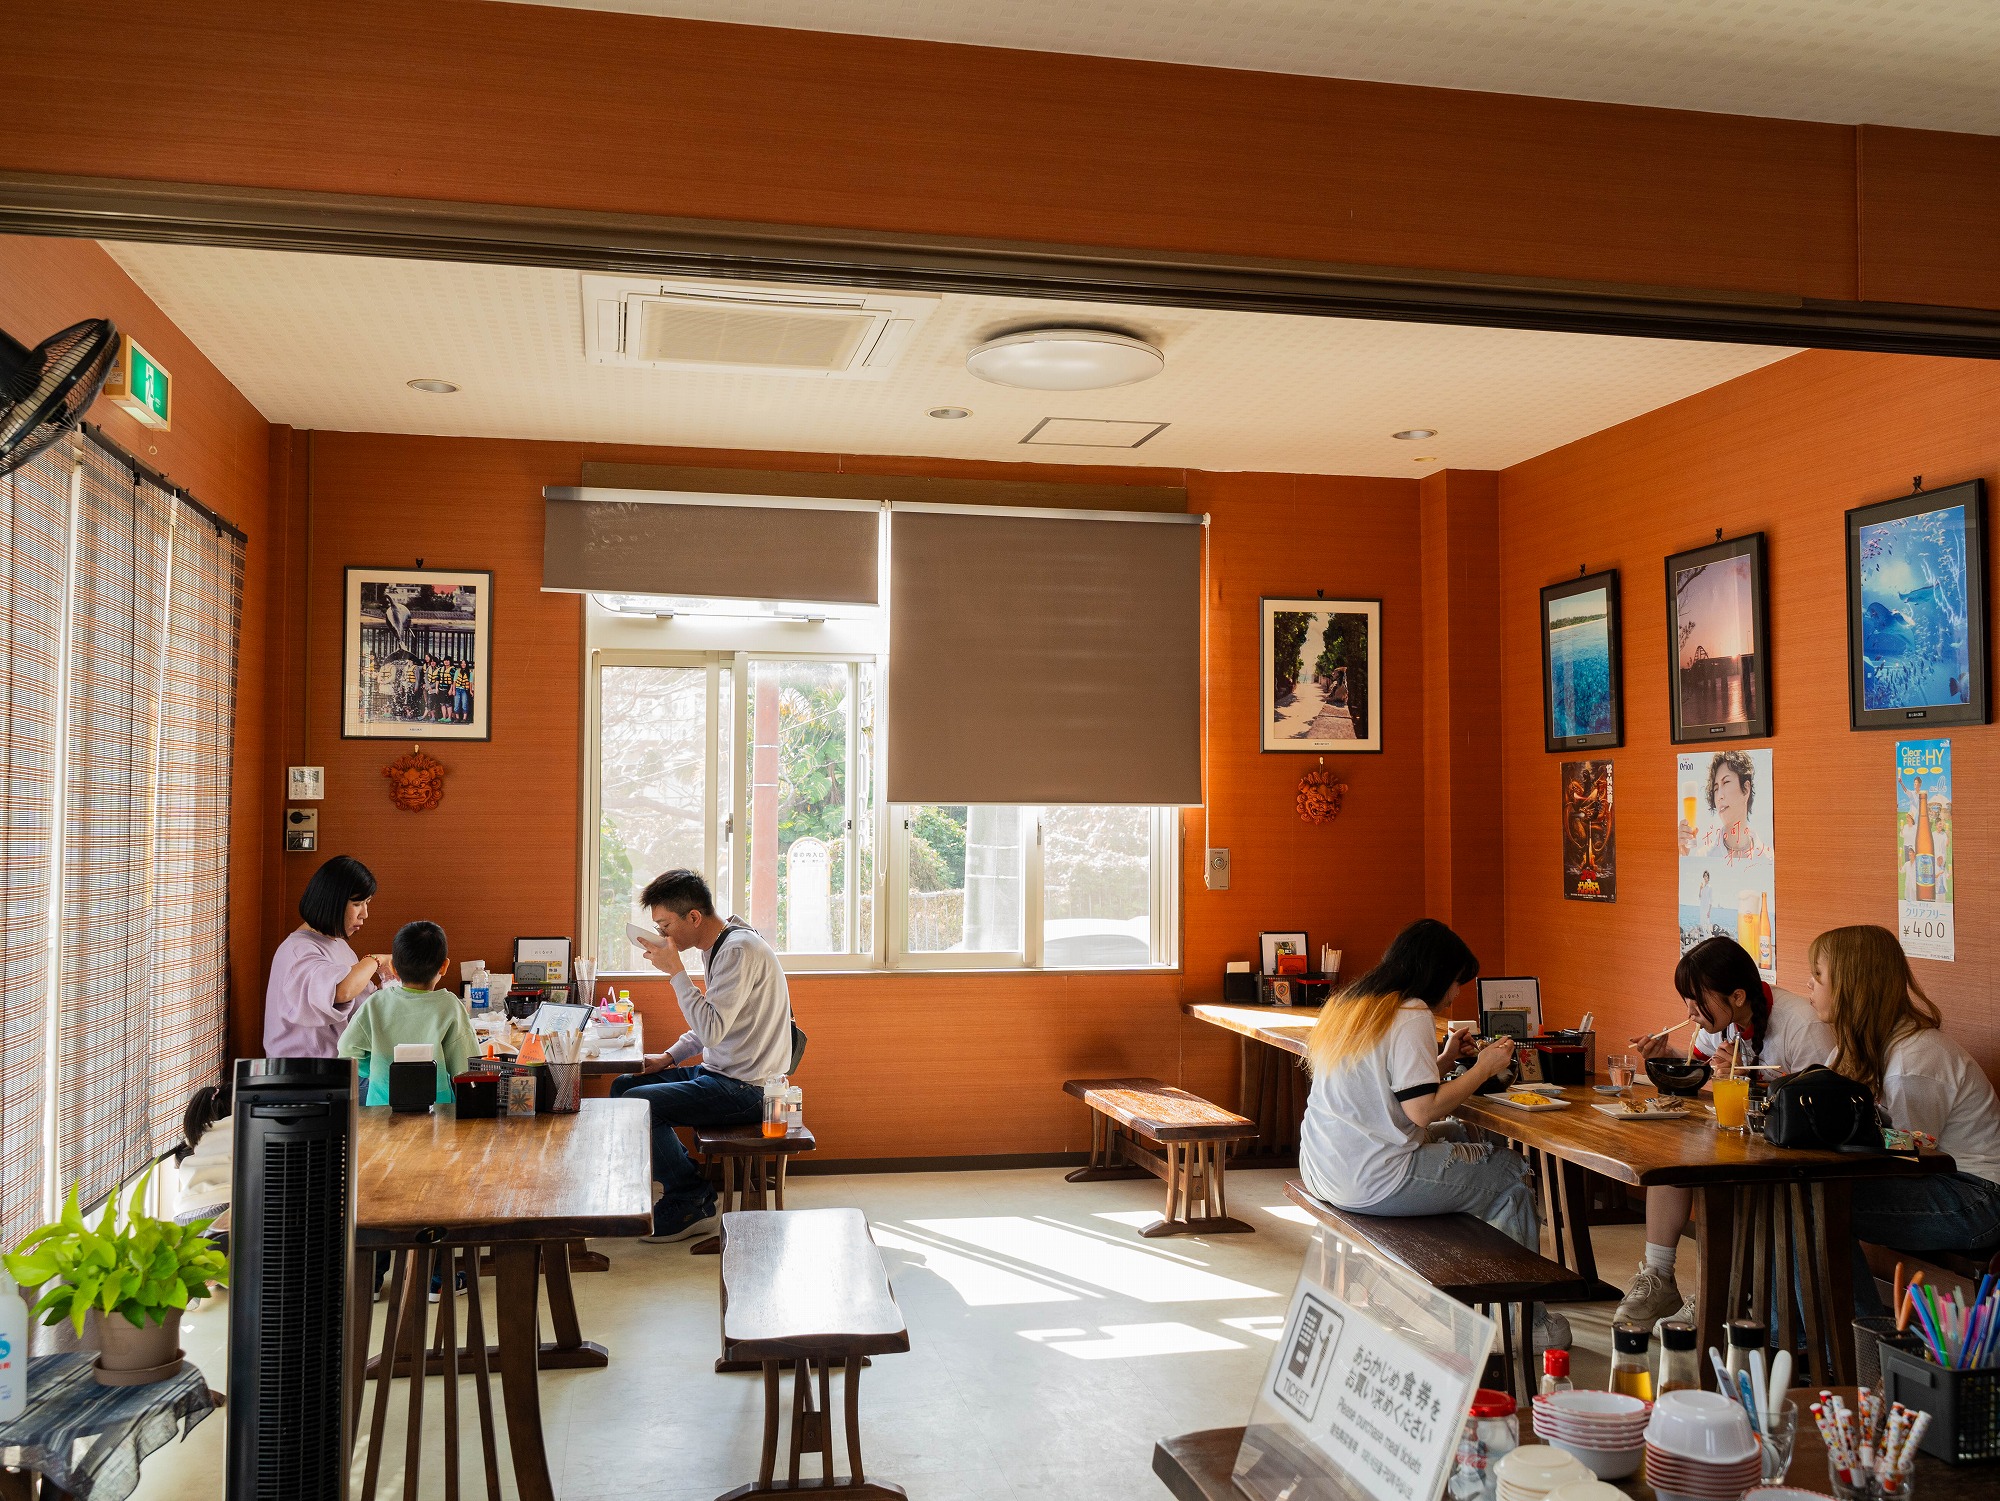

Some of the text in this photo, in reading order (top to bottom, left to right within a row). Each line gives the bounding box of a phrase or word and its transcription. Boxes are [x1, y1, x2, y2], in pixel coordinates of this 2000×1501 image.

[1901, 746, 1923, 758] Clear
[1925, 748, 1945, 766] HY
[1903, 757, 1921, 767] FREE
[1905, 907, 1947, 919] クリアフリー
[1903, 921, 1945, 938] ¥400
[1283, 1377, 1309, 1407] TICKET
[1353, 1345, 1441, 1422] あらかじめ食券を
[1345, 1368, 1433, 1443] お買い求めください
[1337, 1396, 1356, 1422] Please
[1355, 1414, 1384, 1444] purchase
[1384, 1436, 1401, 1457] meal
[1400, 1446, 1423, 1475] tickets
